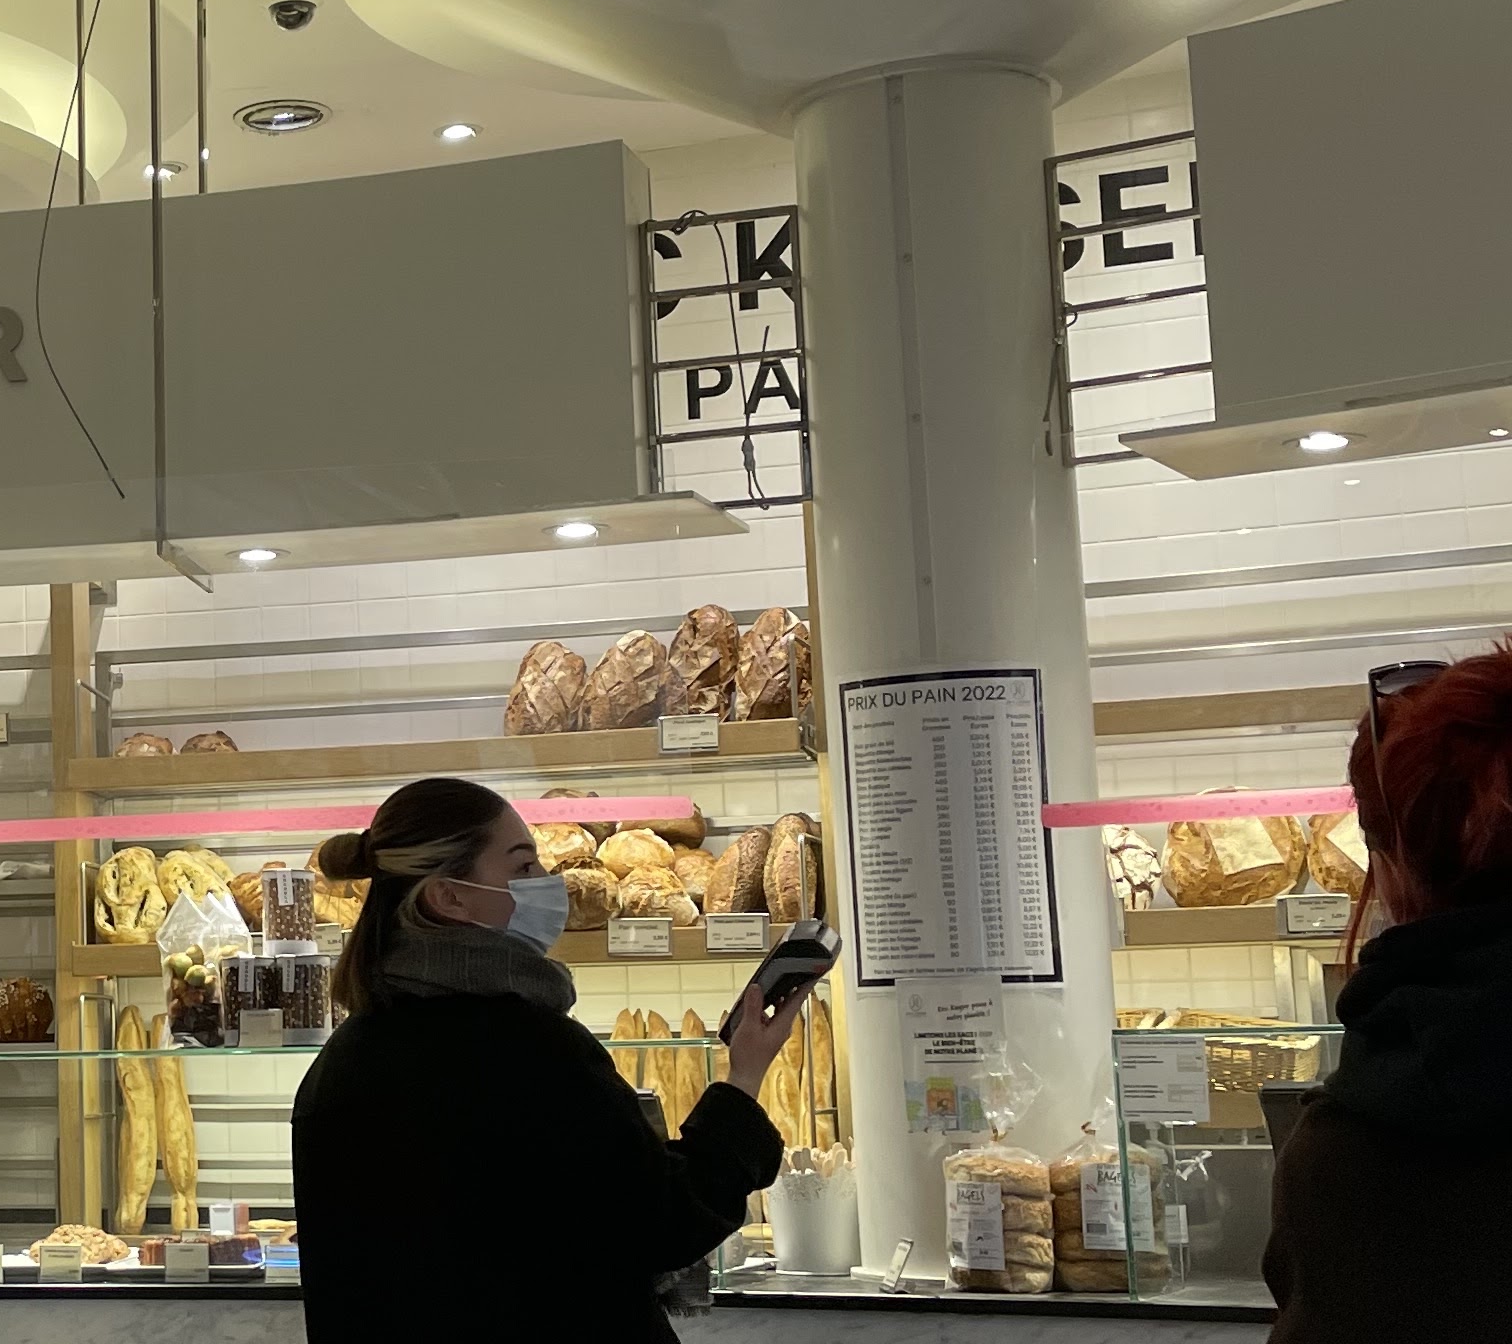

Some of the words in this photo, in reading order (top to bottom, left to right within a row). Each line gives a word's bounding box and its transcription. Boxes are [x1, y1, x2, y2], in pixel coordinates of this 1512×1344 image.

[848, 695, 877, 712] PRIX
[883, 691, 906, 707] DU
[912, 687, 955, 704] PAIN
[962, 685, 1006, 702] 2022
